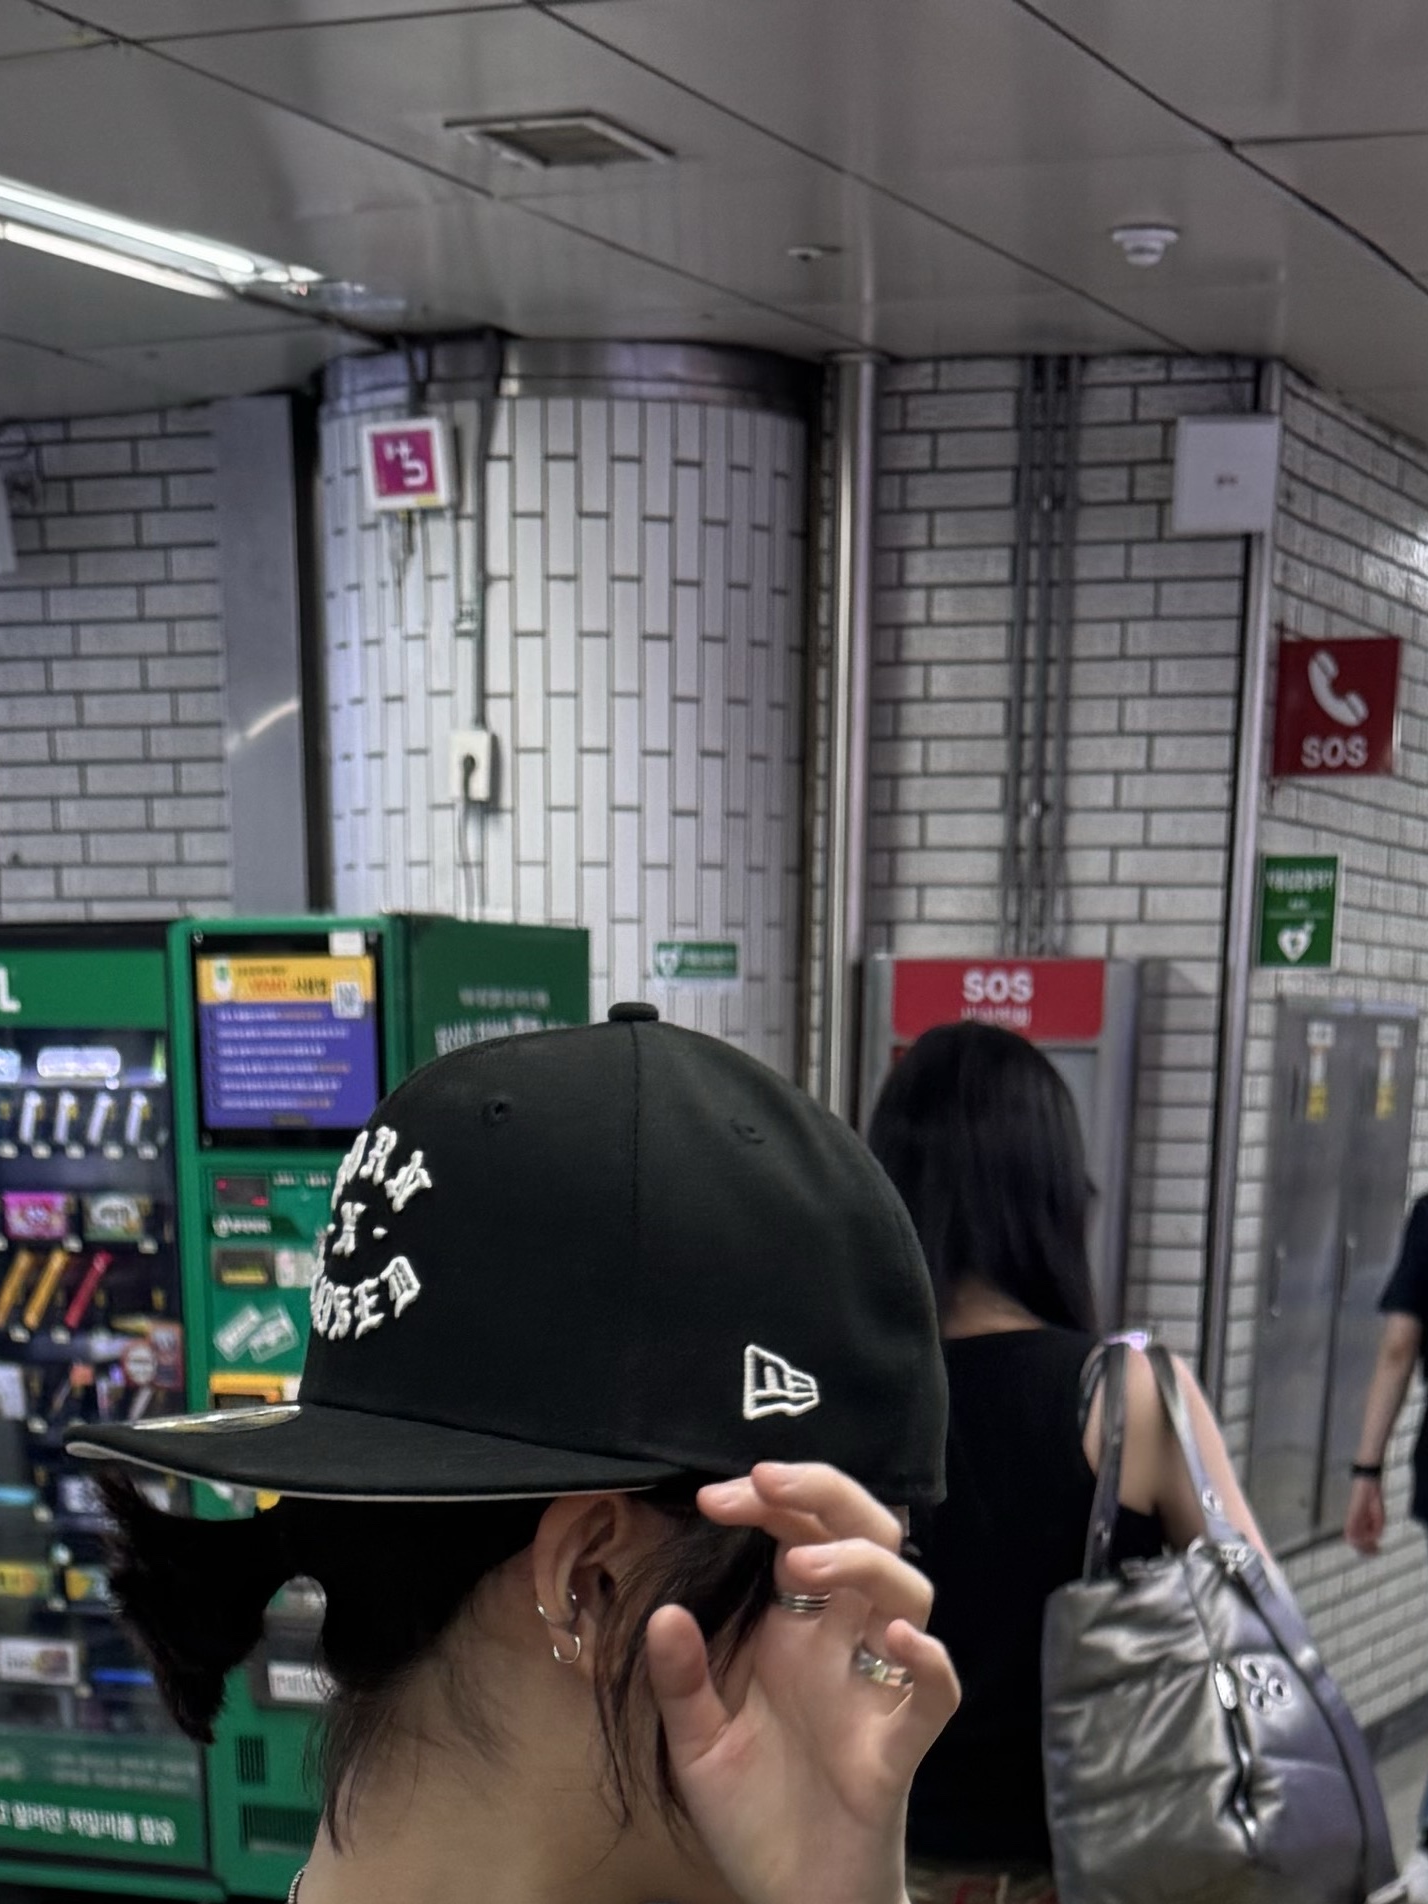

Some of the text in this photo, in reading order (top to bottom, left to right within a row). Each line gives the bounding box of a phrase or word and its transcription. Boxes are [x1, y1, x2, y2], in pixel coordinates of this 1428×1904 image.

[1301, 735, 1368, 769] SOS
[962, 968, 1033, 1003] SOS
[330, 1125, 433, 1213] RN
[310, 1230, 422, 1341] SED
